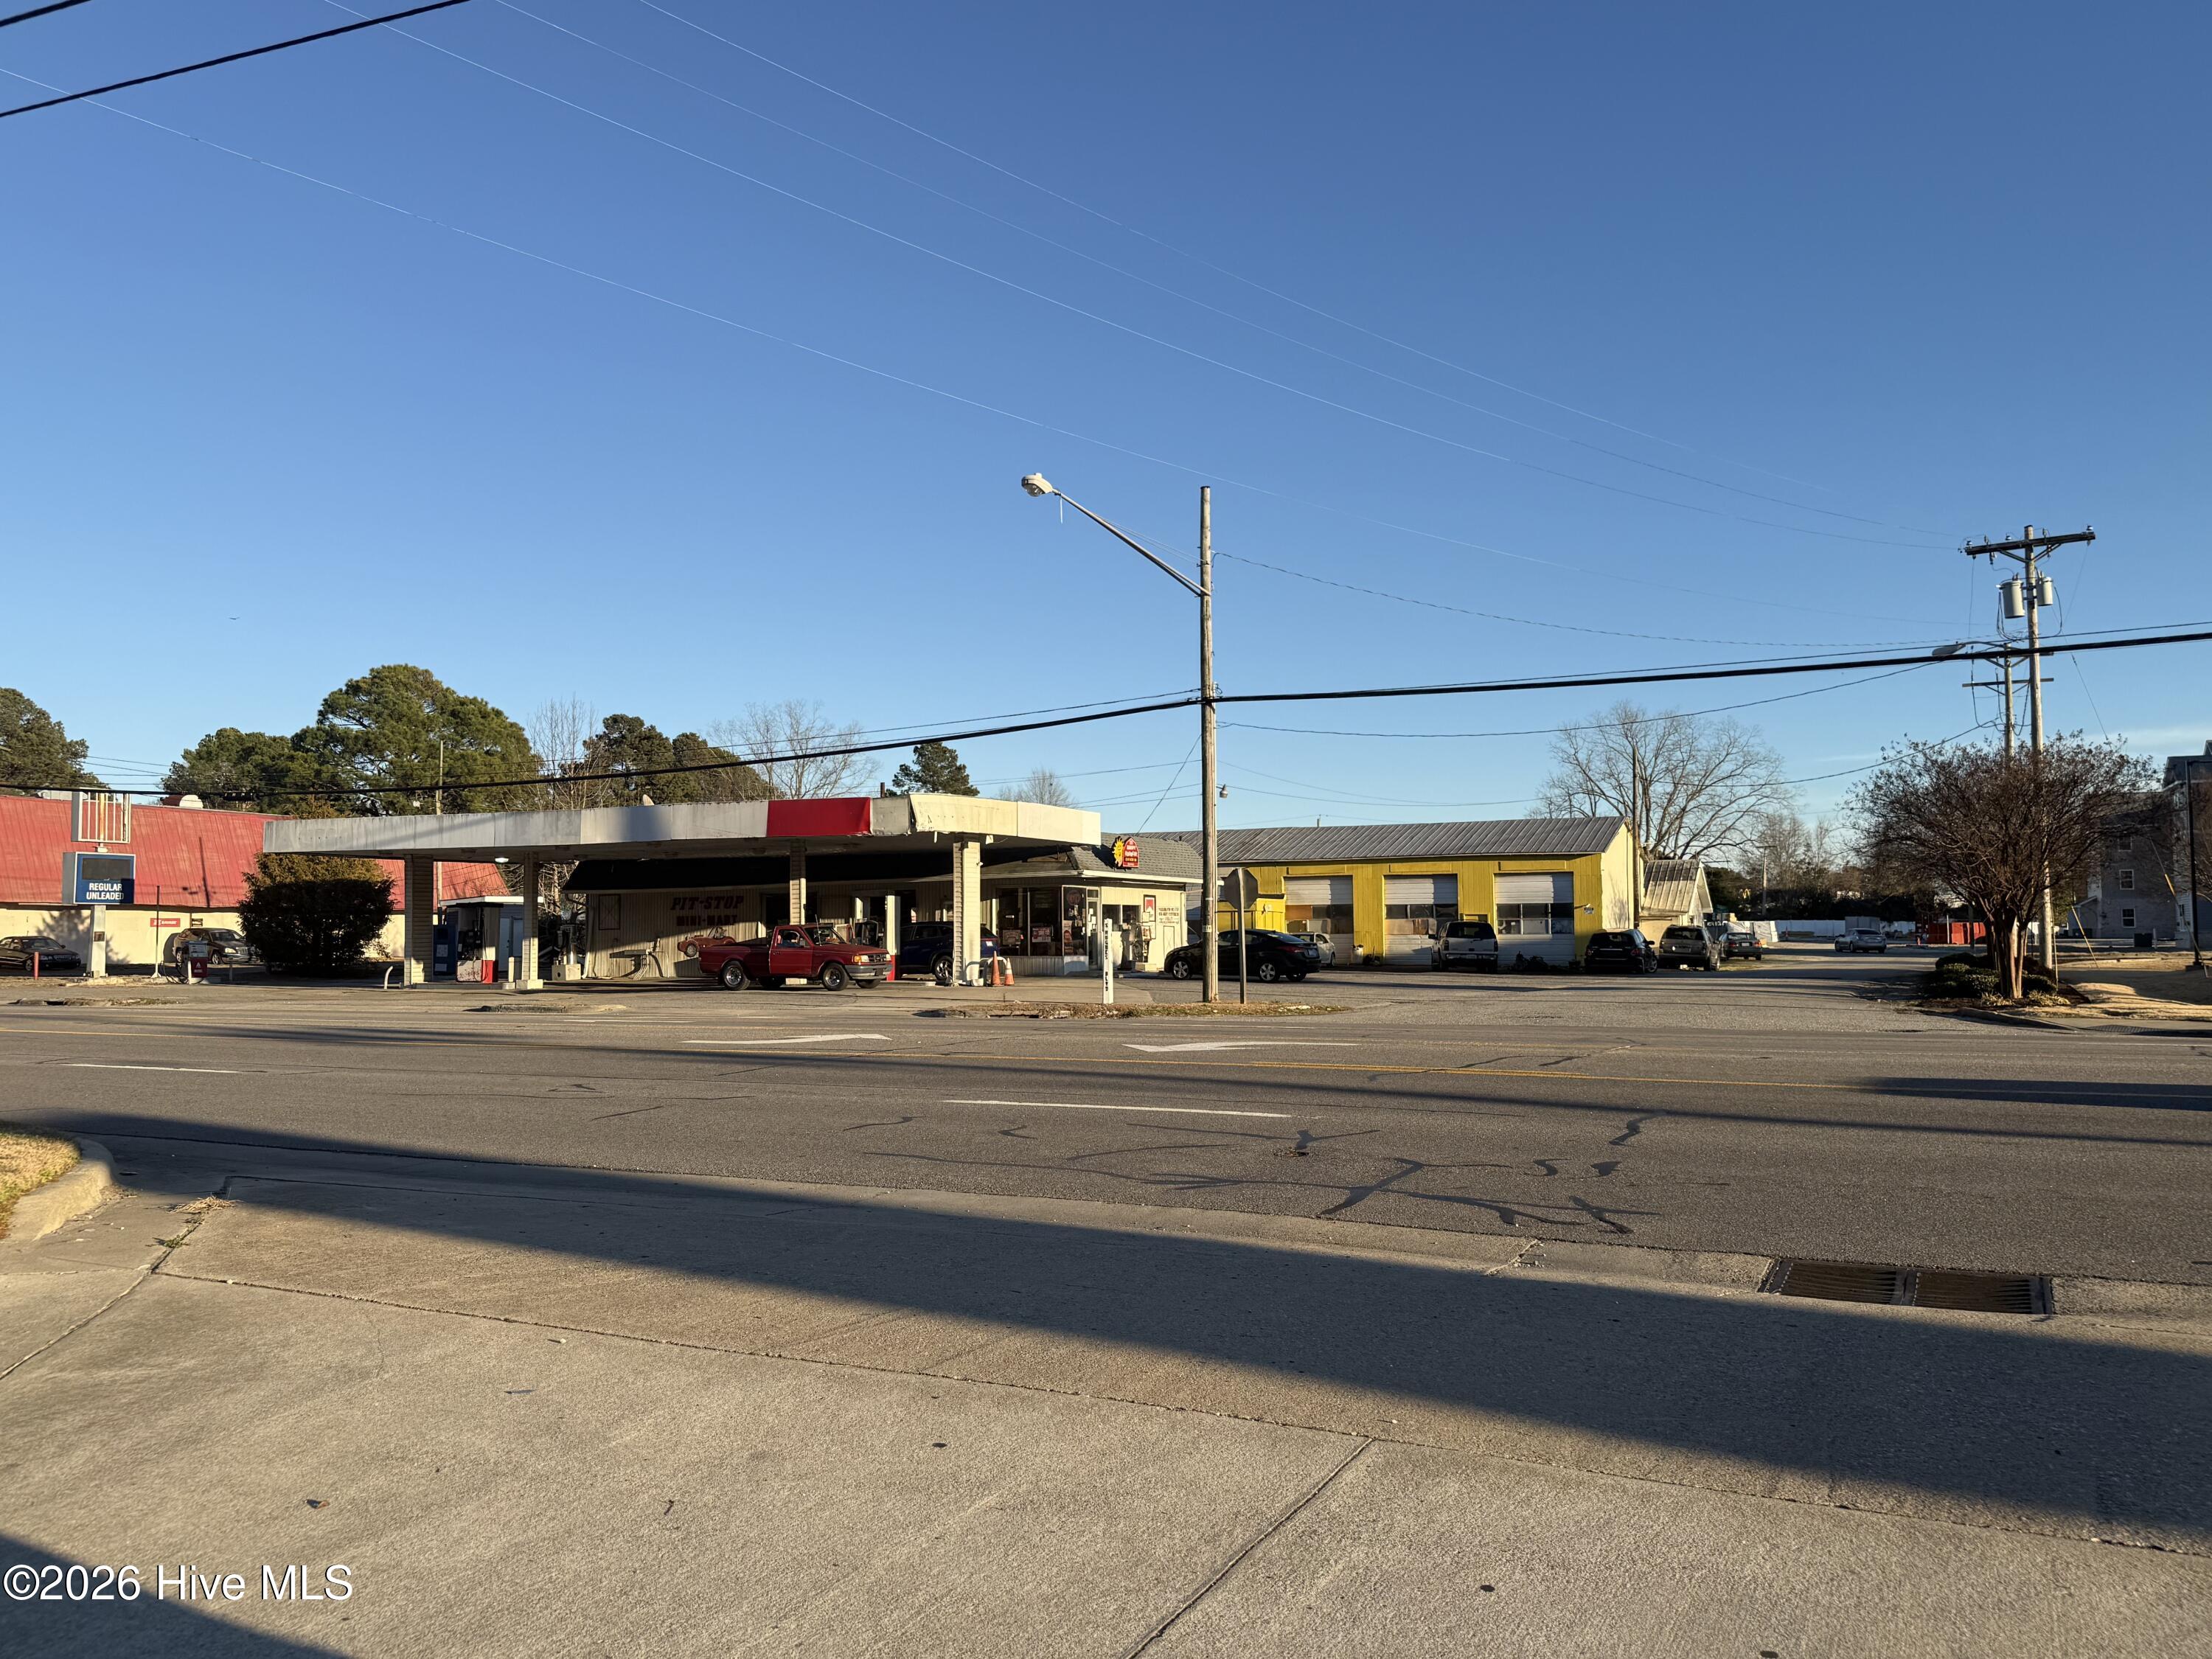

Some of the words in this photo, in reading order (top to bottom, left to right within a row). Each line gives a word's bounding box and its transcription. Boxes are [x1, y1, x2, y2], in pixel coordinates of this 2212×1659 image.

[88, 883, 122, 891] REGULAR
[86, 891, 125, 900] UNLEADED
[670, 895, 744, 910] PIT-STOP
[676, 914, 737, 926] MINI-MART
